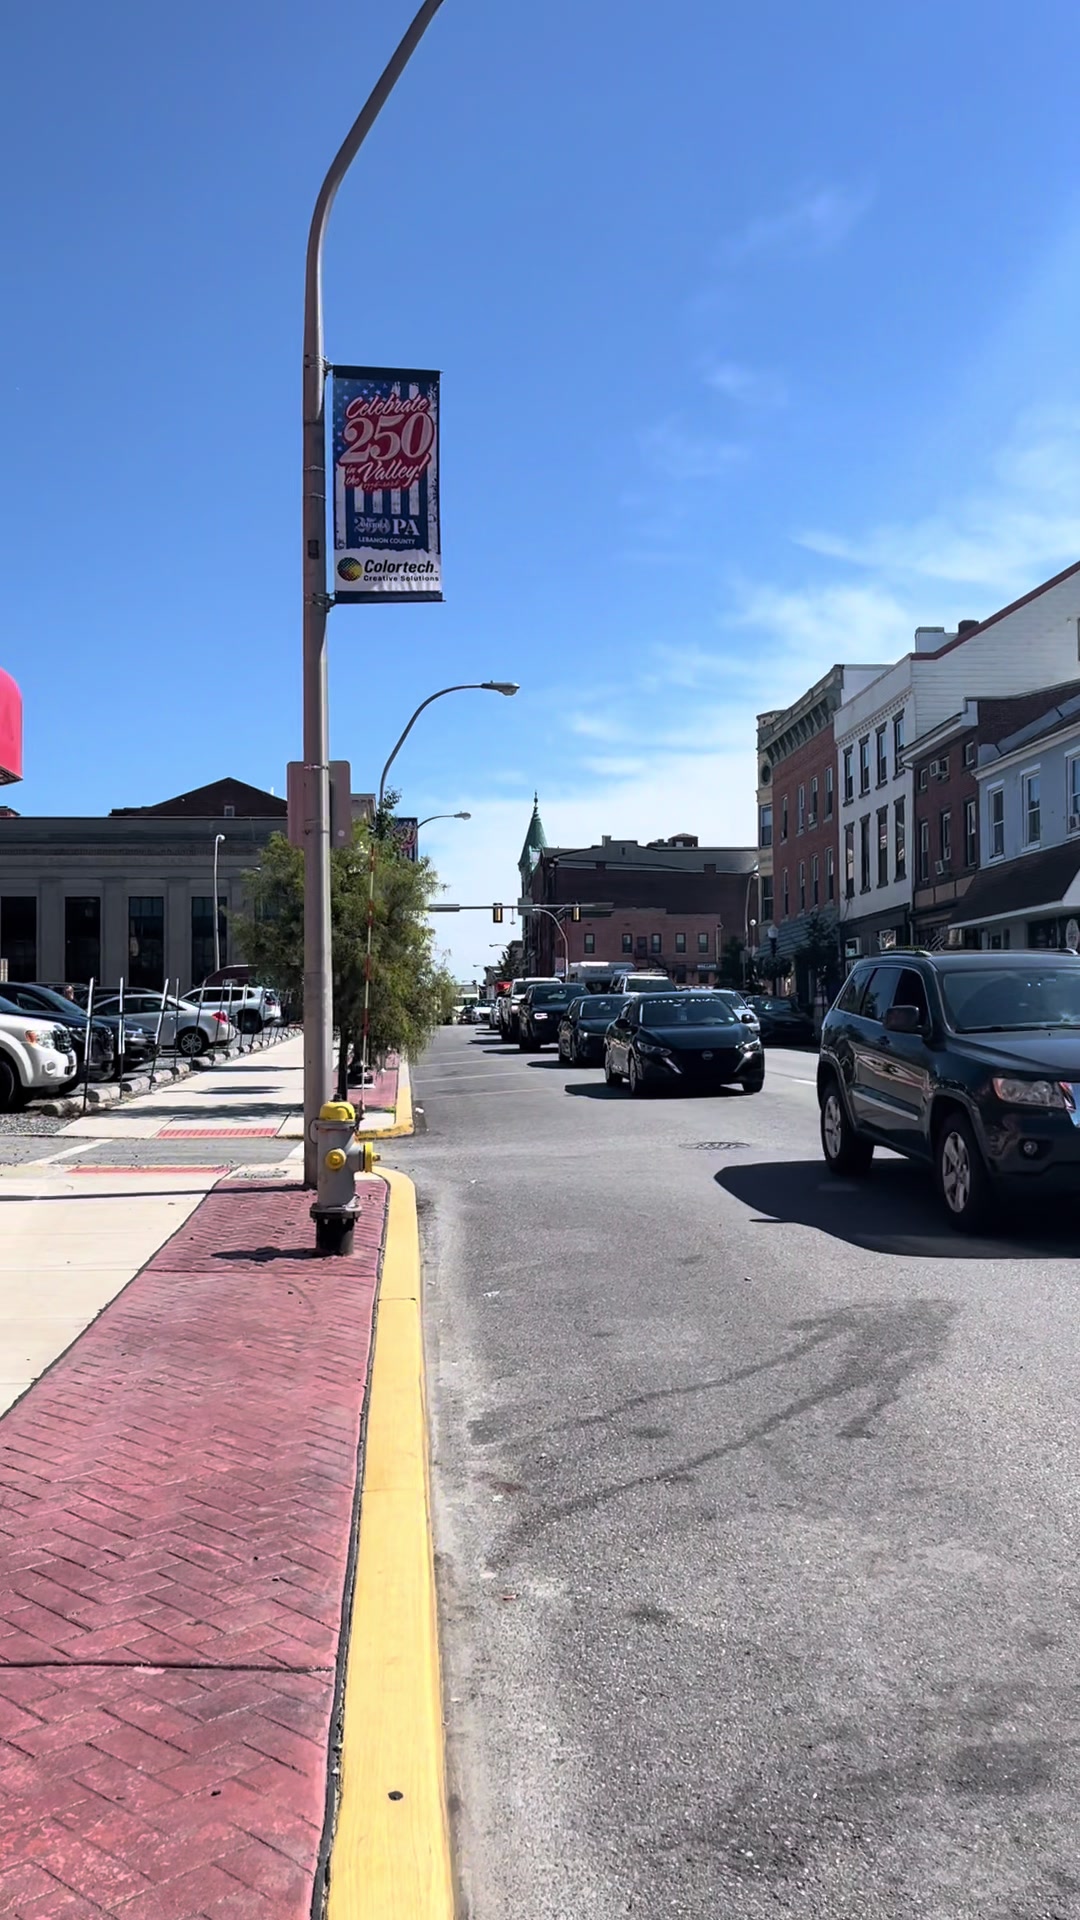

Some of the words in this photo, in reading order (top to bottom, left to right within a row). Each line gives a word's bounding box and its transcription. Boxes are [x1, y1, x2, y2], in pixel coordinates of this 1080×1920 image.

[346, 394, 428, 418] Celebrate
[339, 412, 434, 463] 250
[357, 453, 429, 488] Valley!
[392, 518, 420, 536] PA
[358, 536, 389, 544] LEBANON
[390, 537, 416, 545] COUNTY
[364, 559, 435, 574] Colortech
